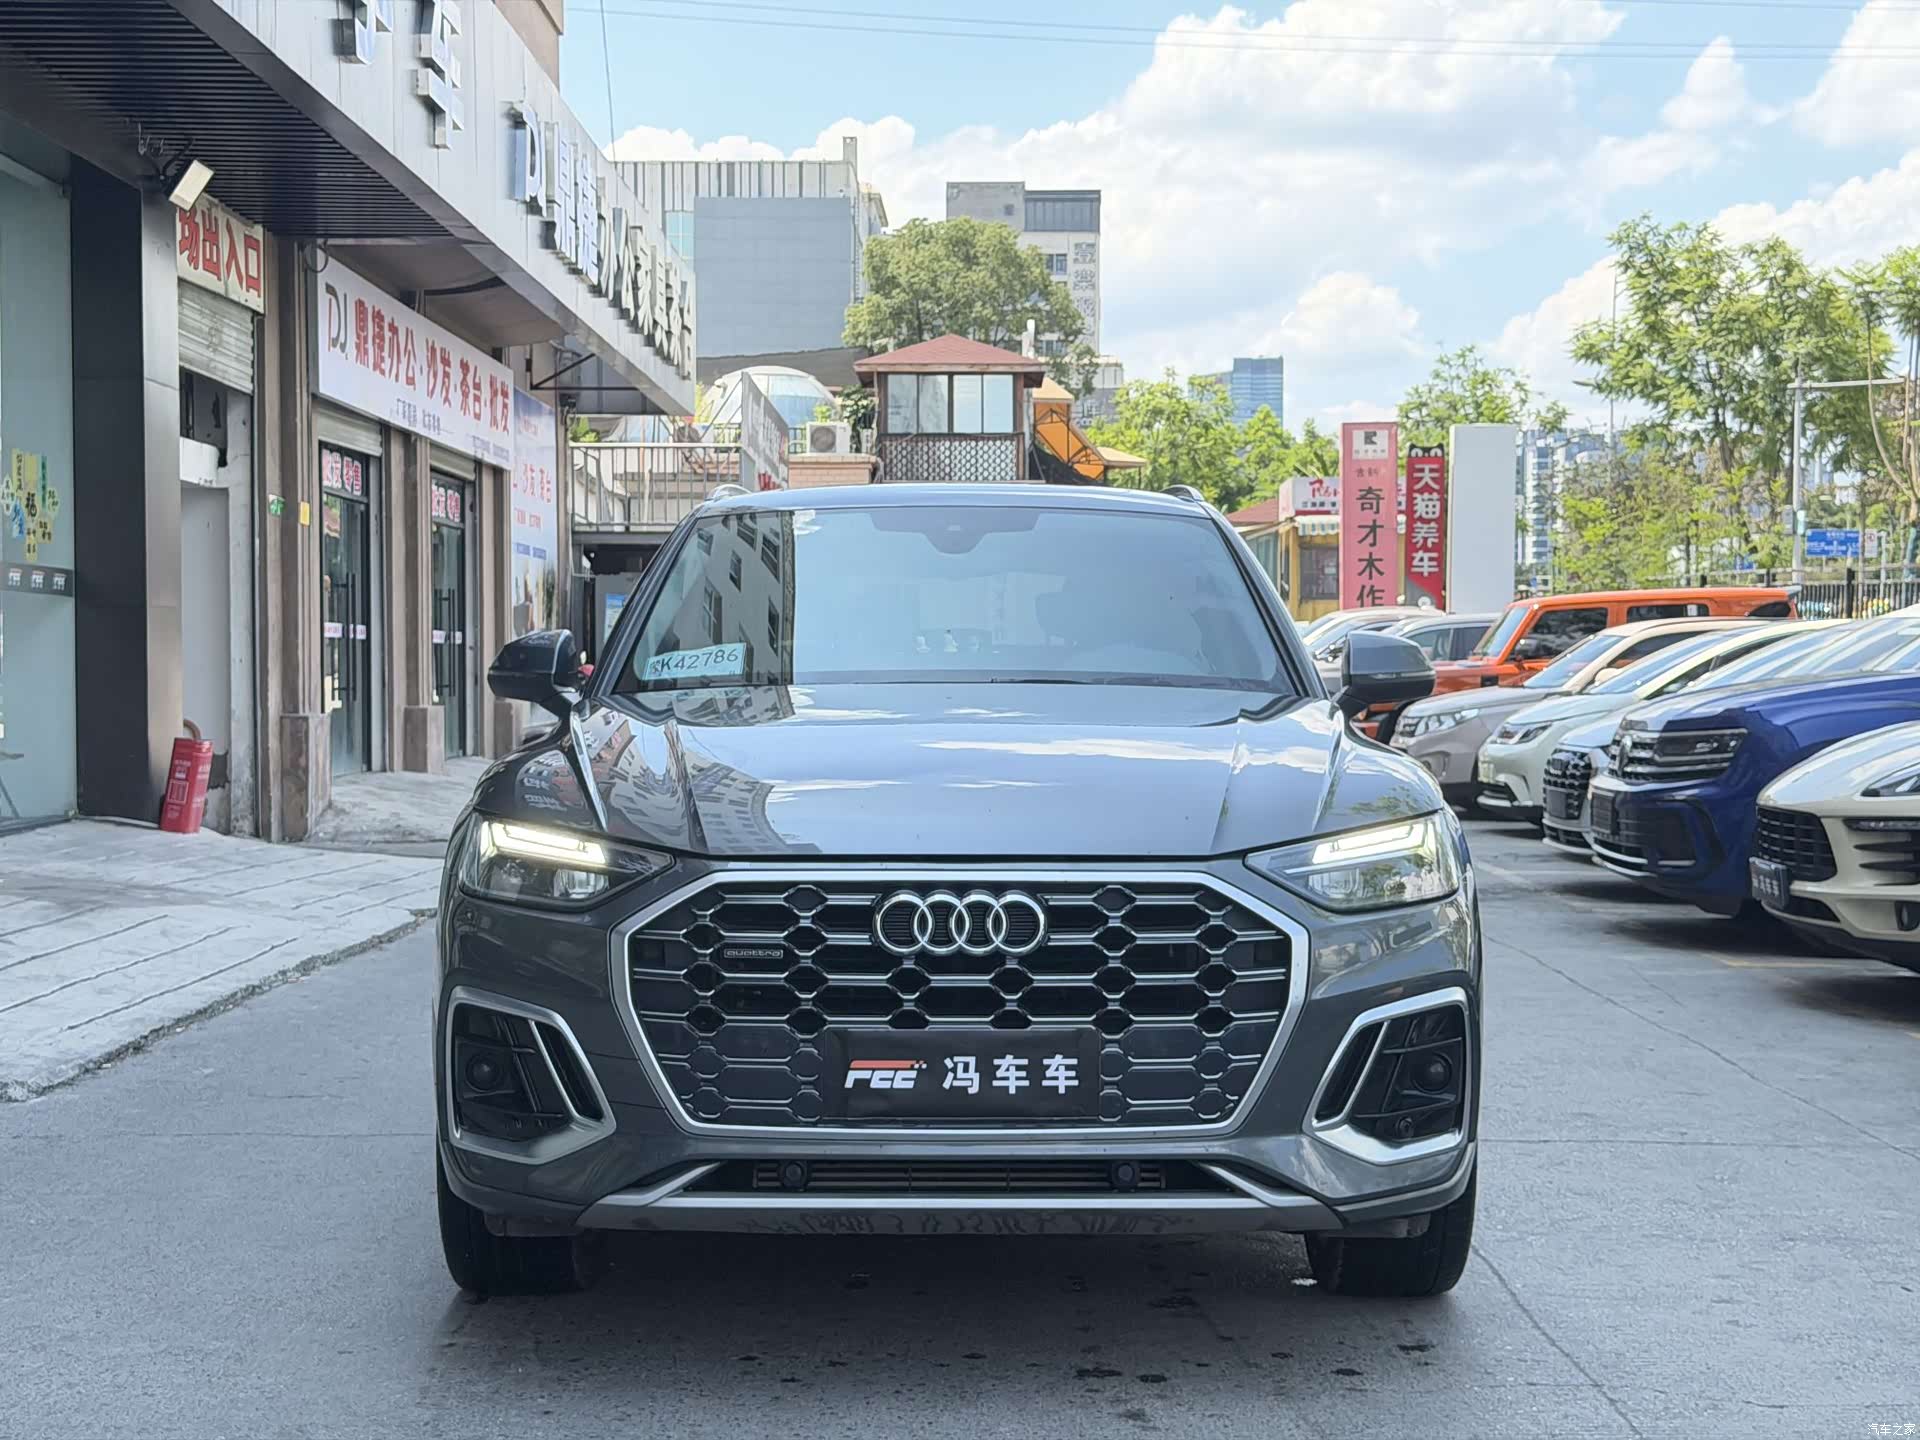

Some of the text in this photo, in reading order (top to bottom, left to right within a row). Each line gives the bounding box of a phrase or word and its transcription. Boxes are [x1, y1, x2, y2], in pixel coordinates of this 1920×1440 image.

[1356, 486, 1385, 607] 奇才木作
[1411, 464, 1440, 577] 天猫养车
[942, 1054, 1080, 1095] 冯车车
